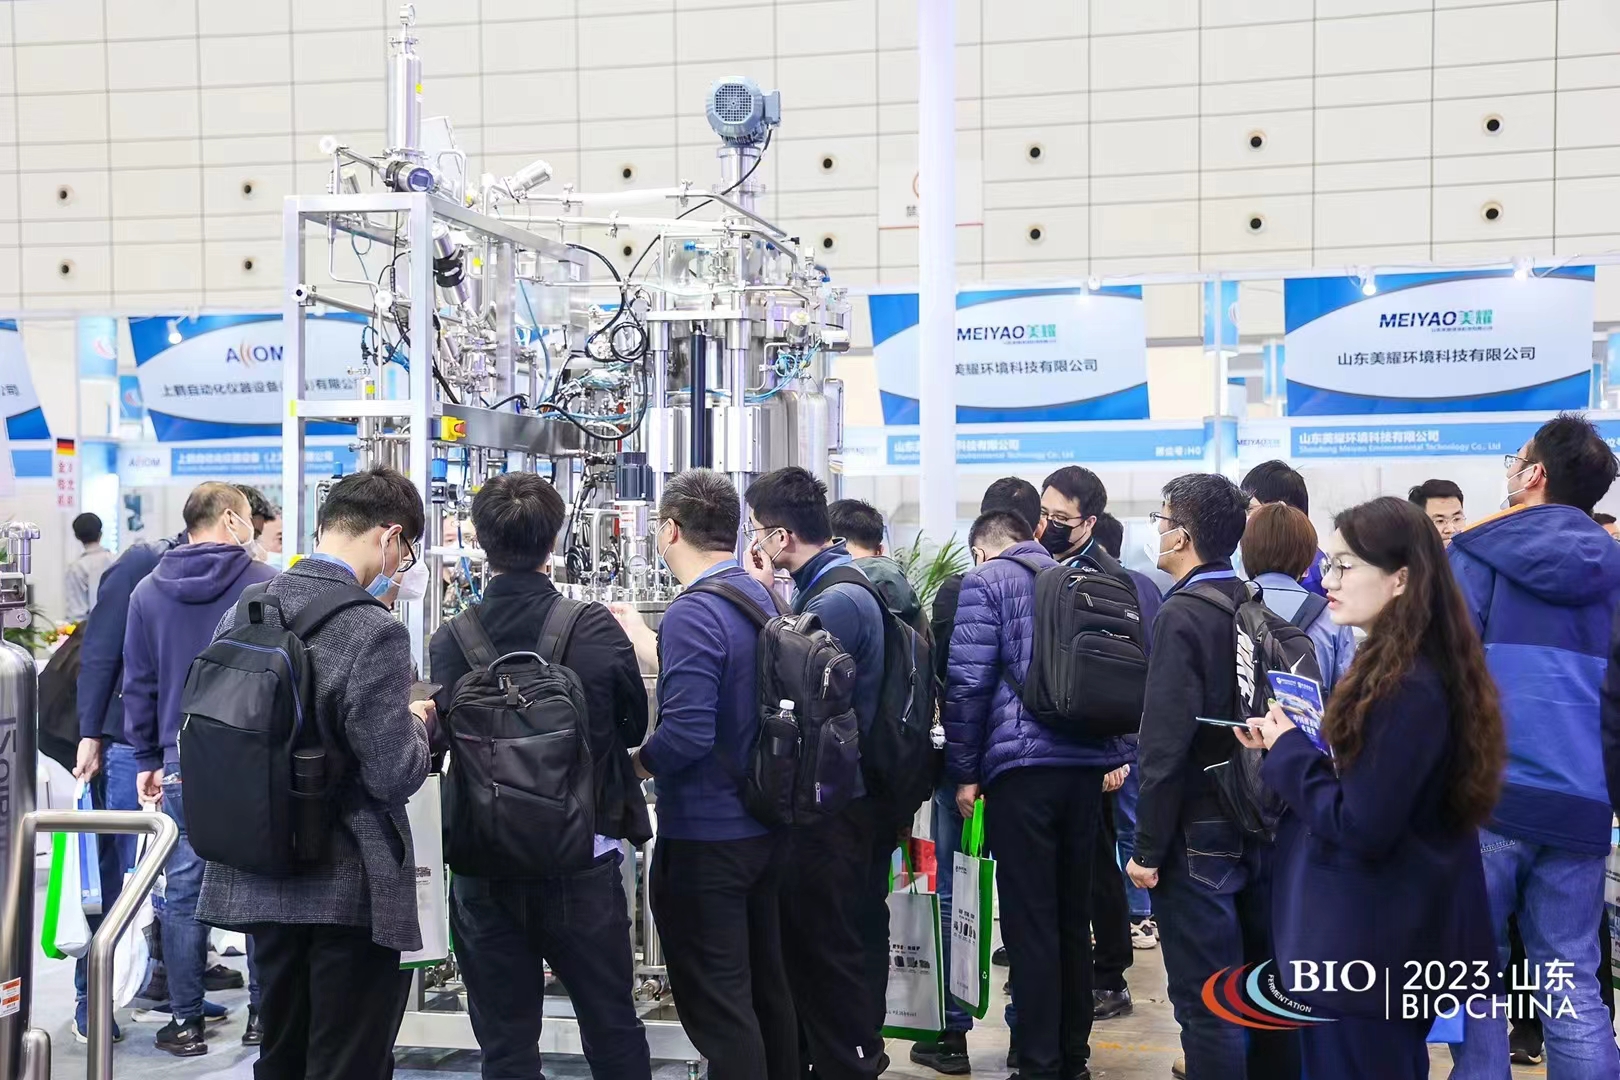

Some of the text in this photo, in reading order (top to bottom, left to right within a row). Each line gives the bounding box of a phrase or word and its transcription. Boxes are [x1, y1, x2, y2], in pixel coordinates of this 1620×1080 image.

[1338, 346, 1536, 366] 山东美耀环境科技有限公司
